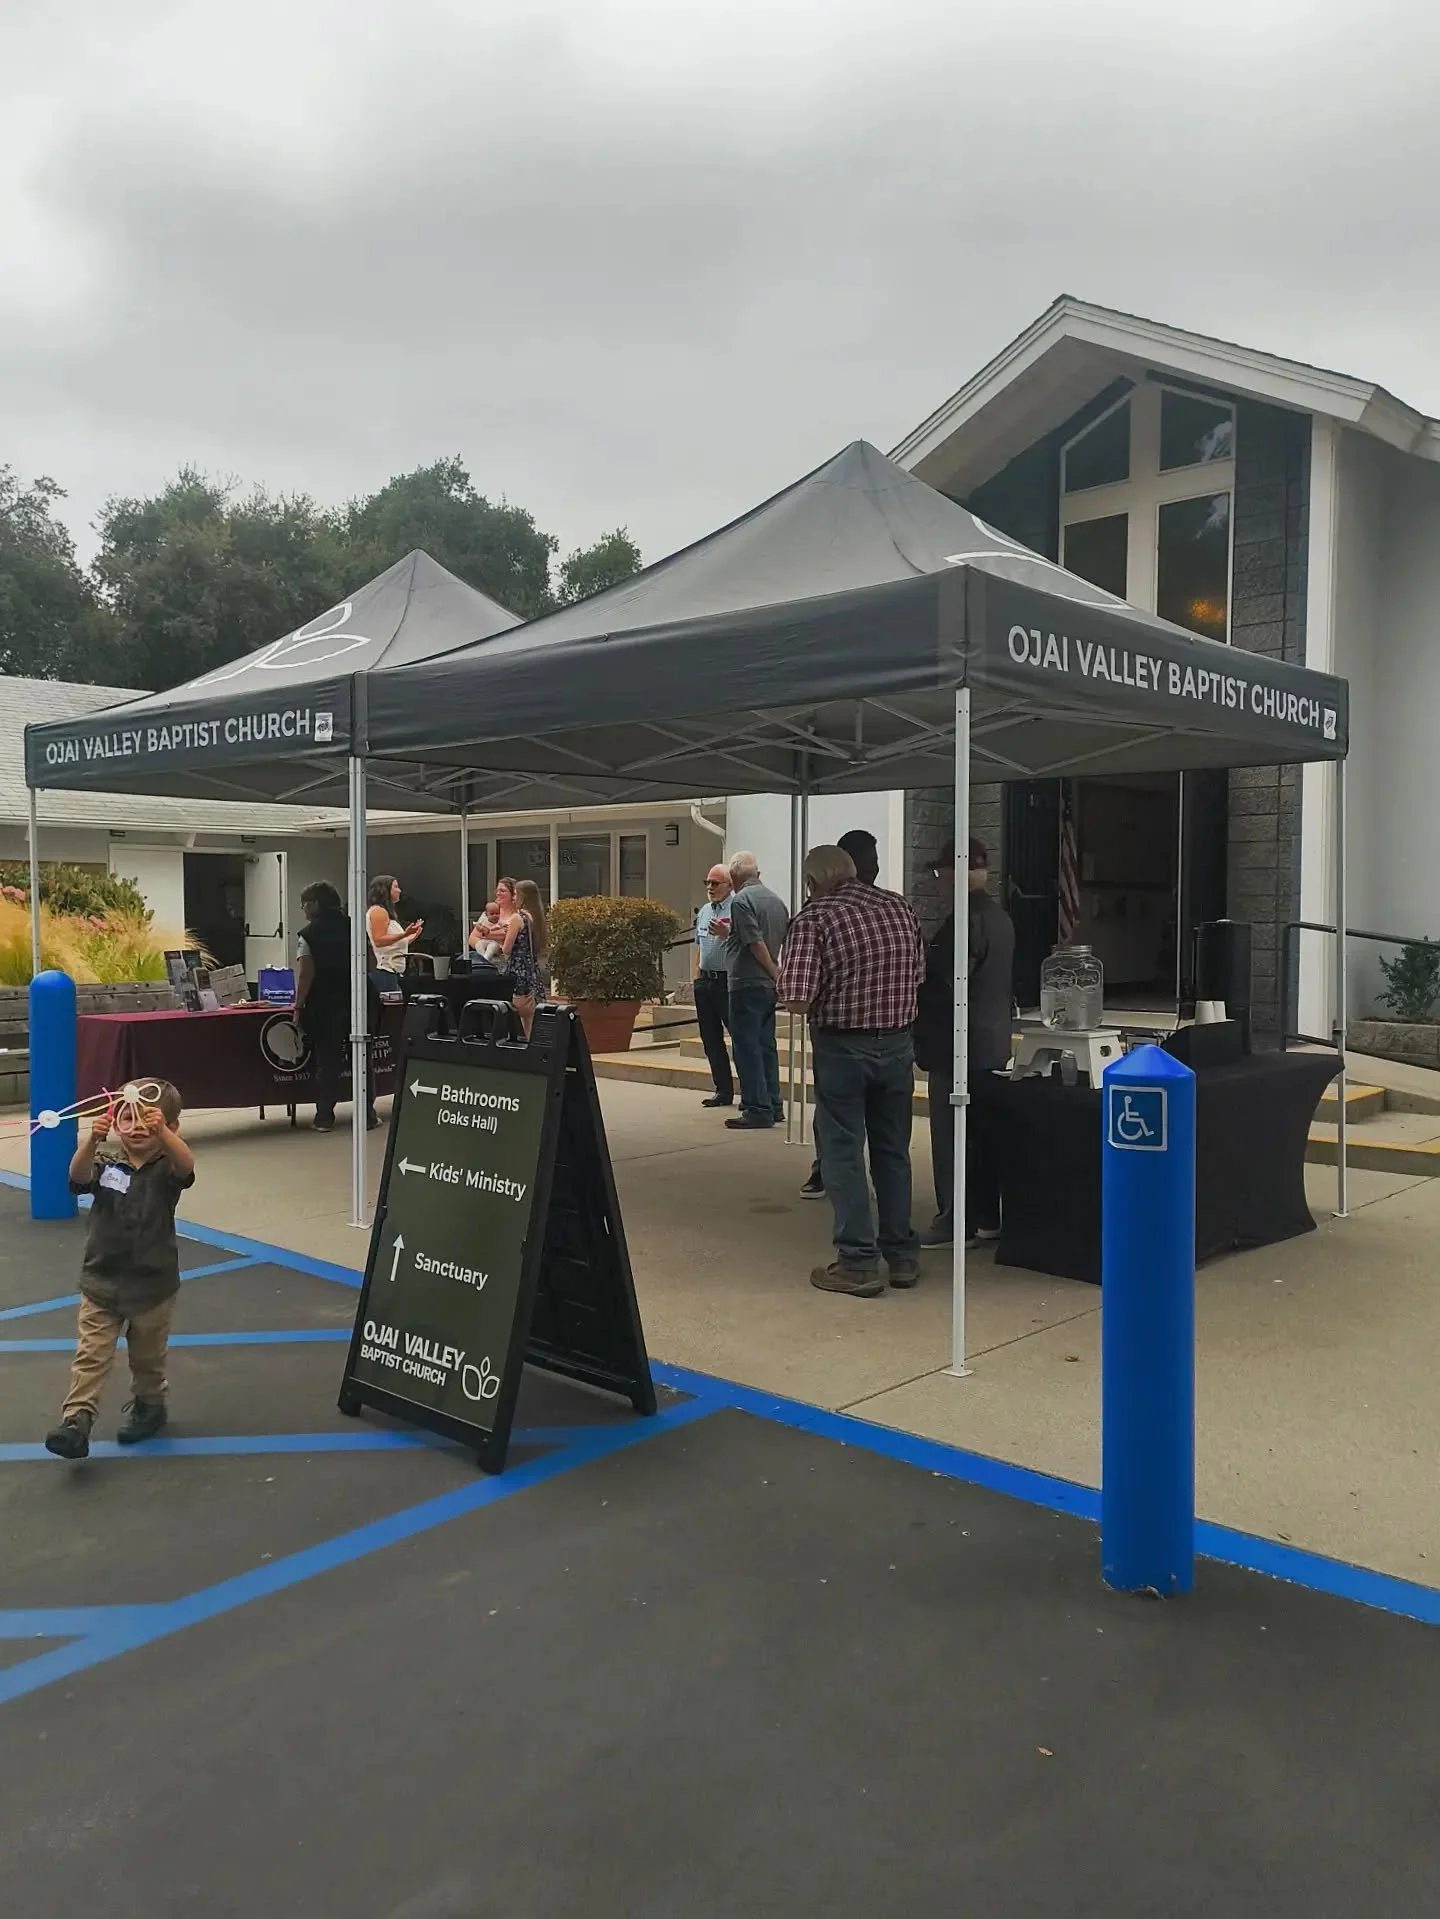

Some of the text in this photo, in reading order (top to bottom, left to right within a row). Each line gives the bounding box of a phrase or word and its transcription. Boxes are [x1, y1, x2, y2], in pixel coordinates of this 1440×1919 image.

[1008, 625, 1320, 728] OJAI VALLEY BAPTIST CHURCH
[46, 740, 79, 765] OJAI
[83, 730, 142, 760] VALLEY
[147, 720, 221, 752] BAPTIST
[224, 709, 310, 743] CHURCH
[440, 1084, 520, 1112] Bathrooms
[437, 1108, 498, 1135] (Oaks Hall)
[429, 1162, 527, 1201] Kids' Ministry
[414, 1252, 489, 1291] Sanctuary
[360, 1344, 447, 1387] BAPTIST CHURCH
[363, 1320, 466, 1371] OJAI VALLEY
